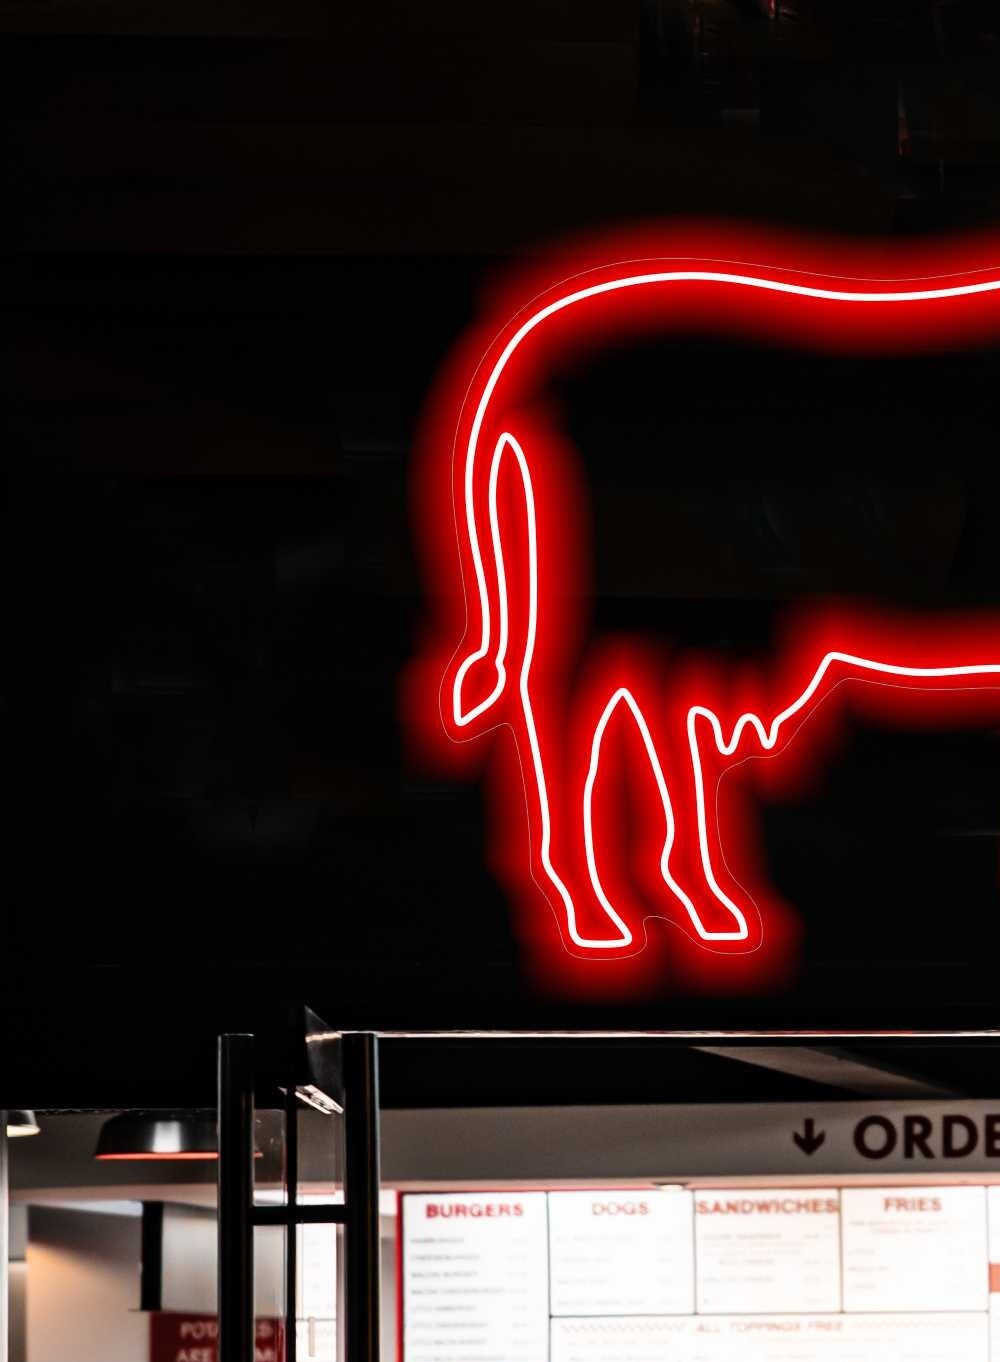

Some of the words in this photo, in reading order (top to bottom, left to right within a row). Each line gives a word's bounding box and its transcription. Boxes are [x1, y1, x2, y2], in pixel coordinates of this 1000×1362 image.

[425, 1202, 524, 1219] BURGERS
[591, 1201, 650, 1217] DOGS
[696, 1198, 839, 1216] SANDWICHES
[883, 1197, 942, 1213] FRIES
